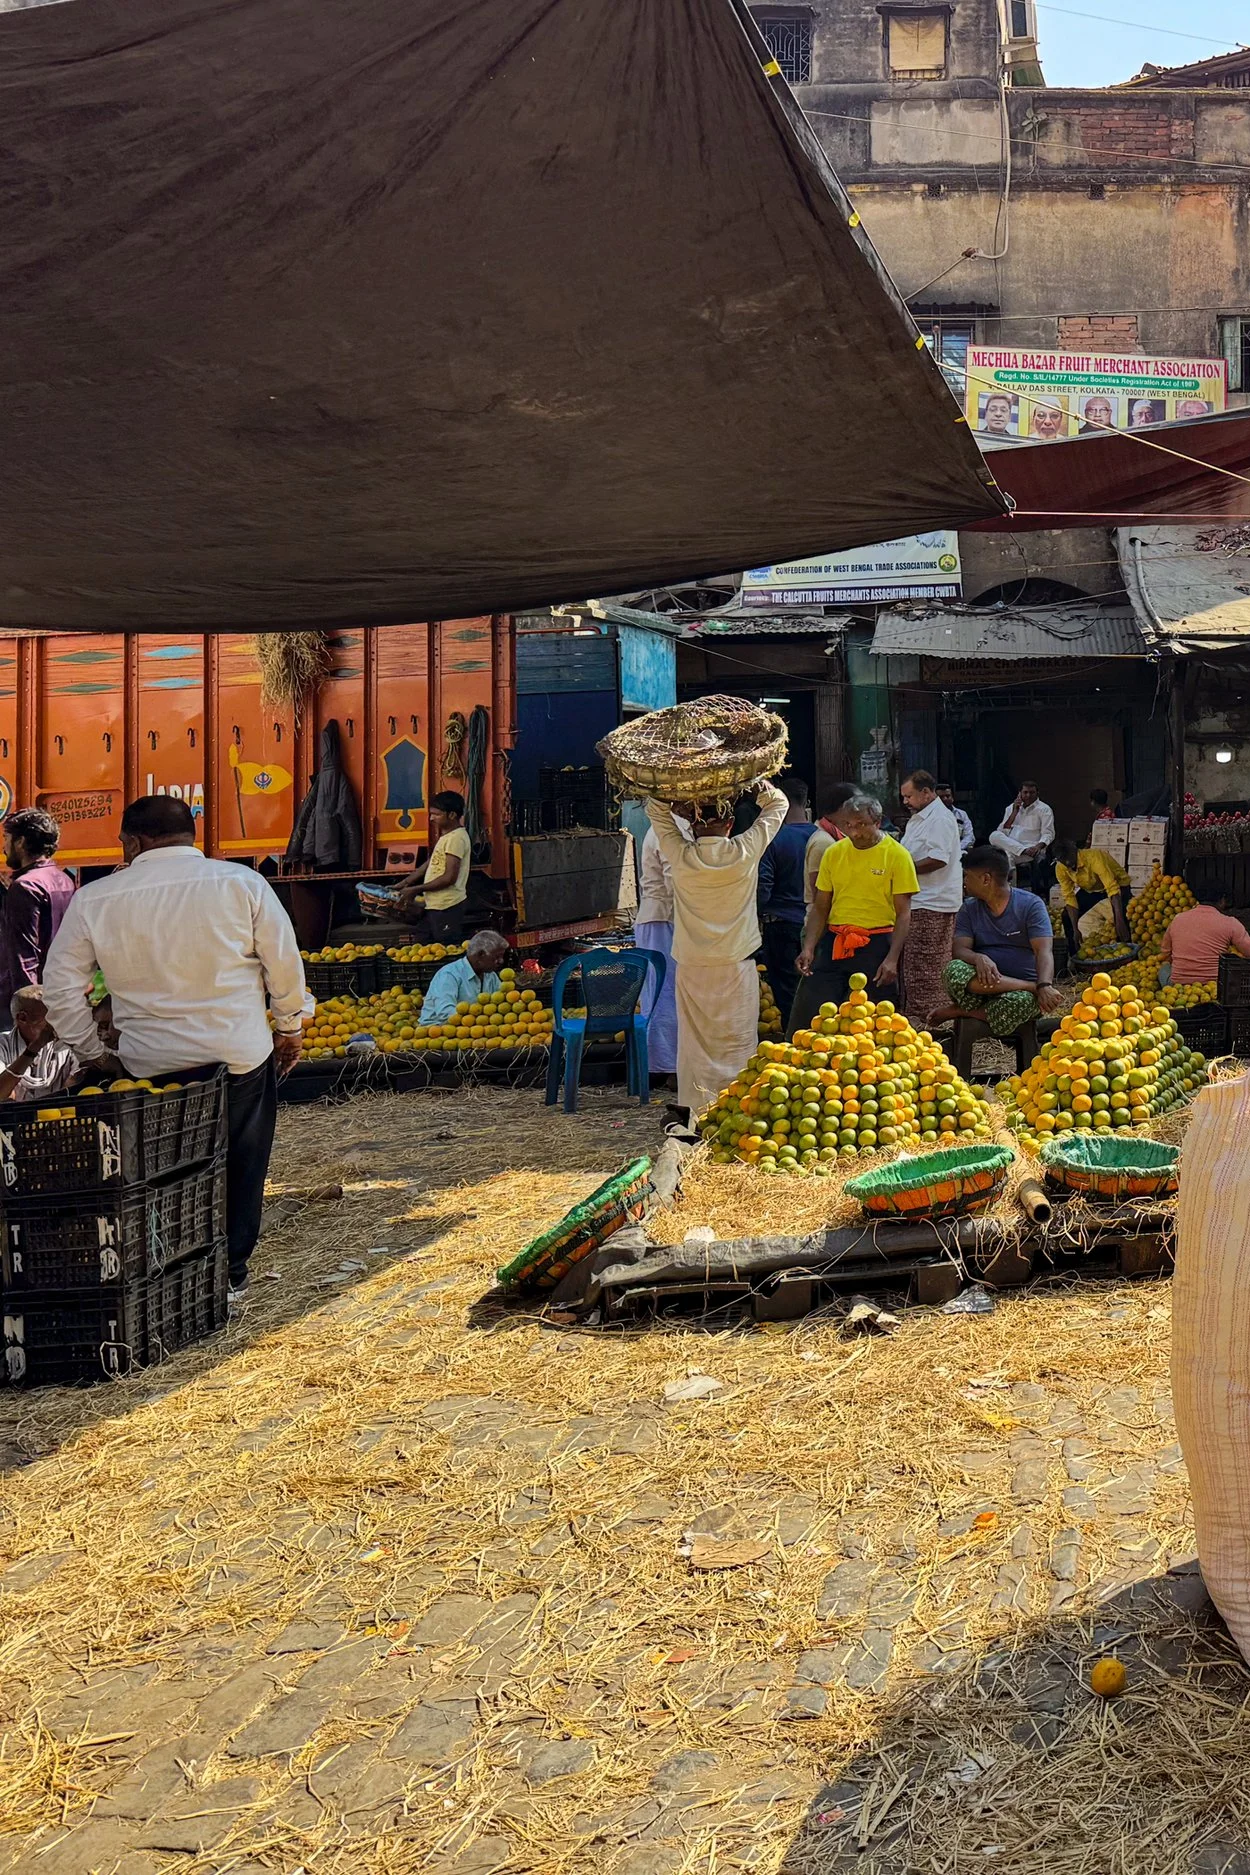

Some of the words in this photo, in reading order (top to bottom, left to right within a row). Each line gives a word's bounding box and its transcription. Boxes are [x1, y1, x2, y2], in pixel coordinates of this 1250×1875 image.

[972, 351, 1018, 368] MECHUA
[1022, 353, 1056, 370] BAZAR
[1059, 356, 1092, 372] FRUIT
[1093, 357, 1150, 375] MERCHANT
[1153, 361, 1221, 378] ASSOCIATION
[1090, 376, 1119, 384] Societies
[1121, 378, 1159, 387] Registration
[1029, 384, 1045, 392] DAS
[1047, 385, 1078, 394] STREET,
[1080, 387, 1115, 395] KOLKATA
[1121, 388, 1145, 397] 700007
[1147, 389, 1170, 398] (WEST
[1172, 391, 1206, 399] BENGAL)
[775, 565, 823, 575] CONFEDERATION
[824, 565, 832, 573] OF
[833, 564, 849, 572] WEST
[851, 563, 873, 572] BENGAL
[875, 562, 894, 571] TRADE
[895, 561, 937, 570] ASSOCIATIONS
[771, 592, 782, 603] THE
[783, 591, 812, 603] CALCUTTA
[813, 590, 833, 602] FRUITS
[834, 588, 870, 602] MERCHANTS
[871, 587, 909, 601] ASSOCIATION
[910, 586, 934, 599] MEMBER
